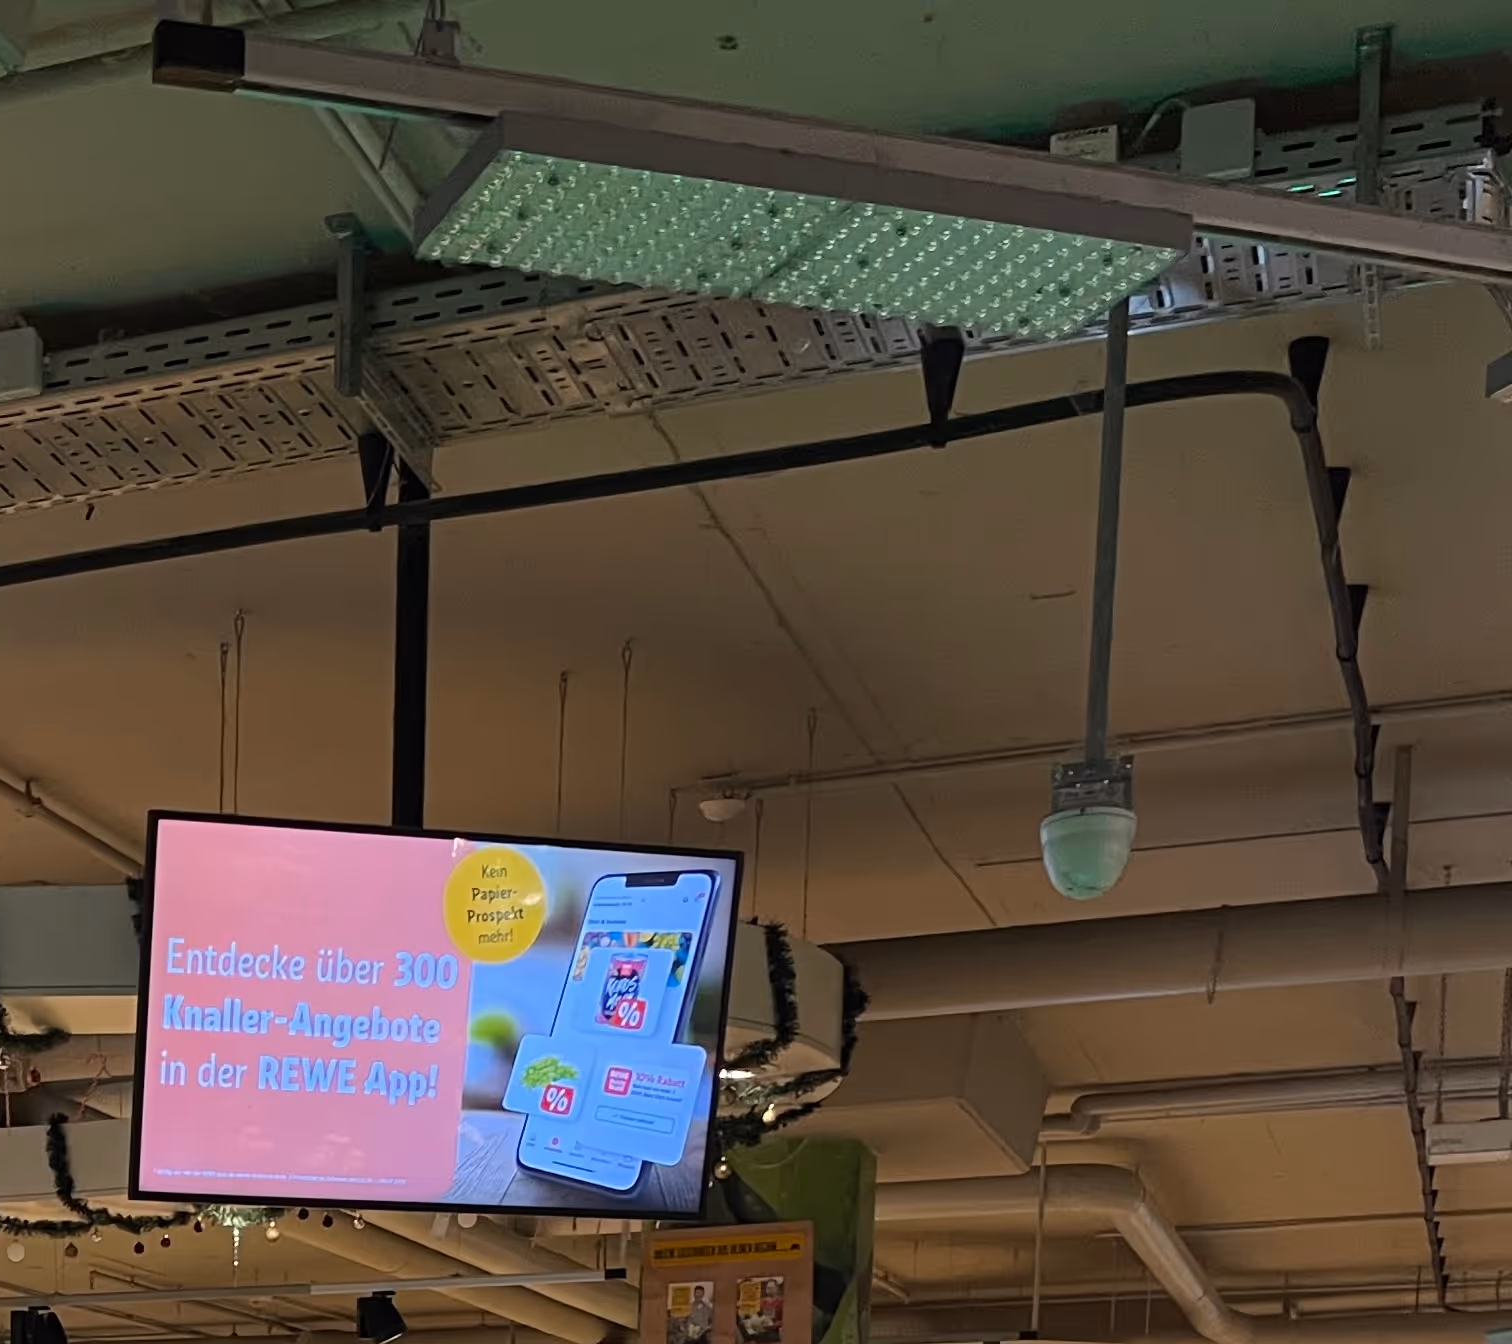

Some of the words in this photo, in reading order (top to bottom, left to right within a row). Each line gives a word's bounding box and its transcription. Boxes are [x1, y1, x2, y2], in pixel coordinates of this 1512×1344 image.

[480, 864, 508, 880] Kein
[471, 886, 518, 907] Papier-
[467, 906, 525, 929] Prospekt
[478, 928, 514, 946] mehr!
[166, 937, 304, 983] Entdecke
[316, 947, 385, 986] über
[393, 951, 459, 990] 300
[161, 994, 442, 1049] Knaller-Angebote
[159, 1051, 187, 1086] in
[197, 1053, 247, 1091] der
[257, 1055, 357, 1095] REWE
[364, 1061, 440, 1105] App!
